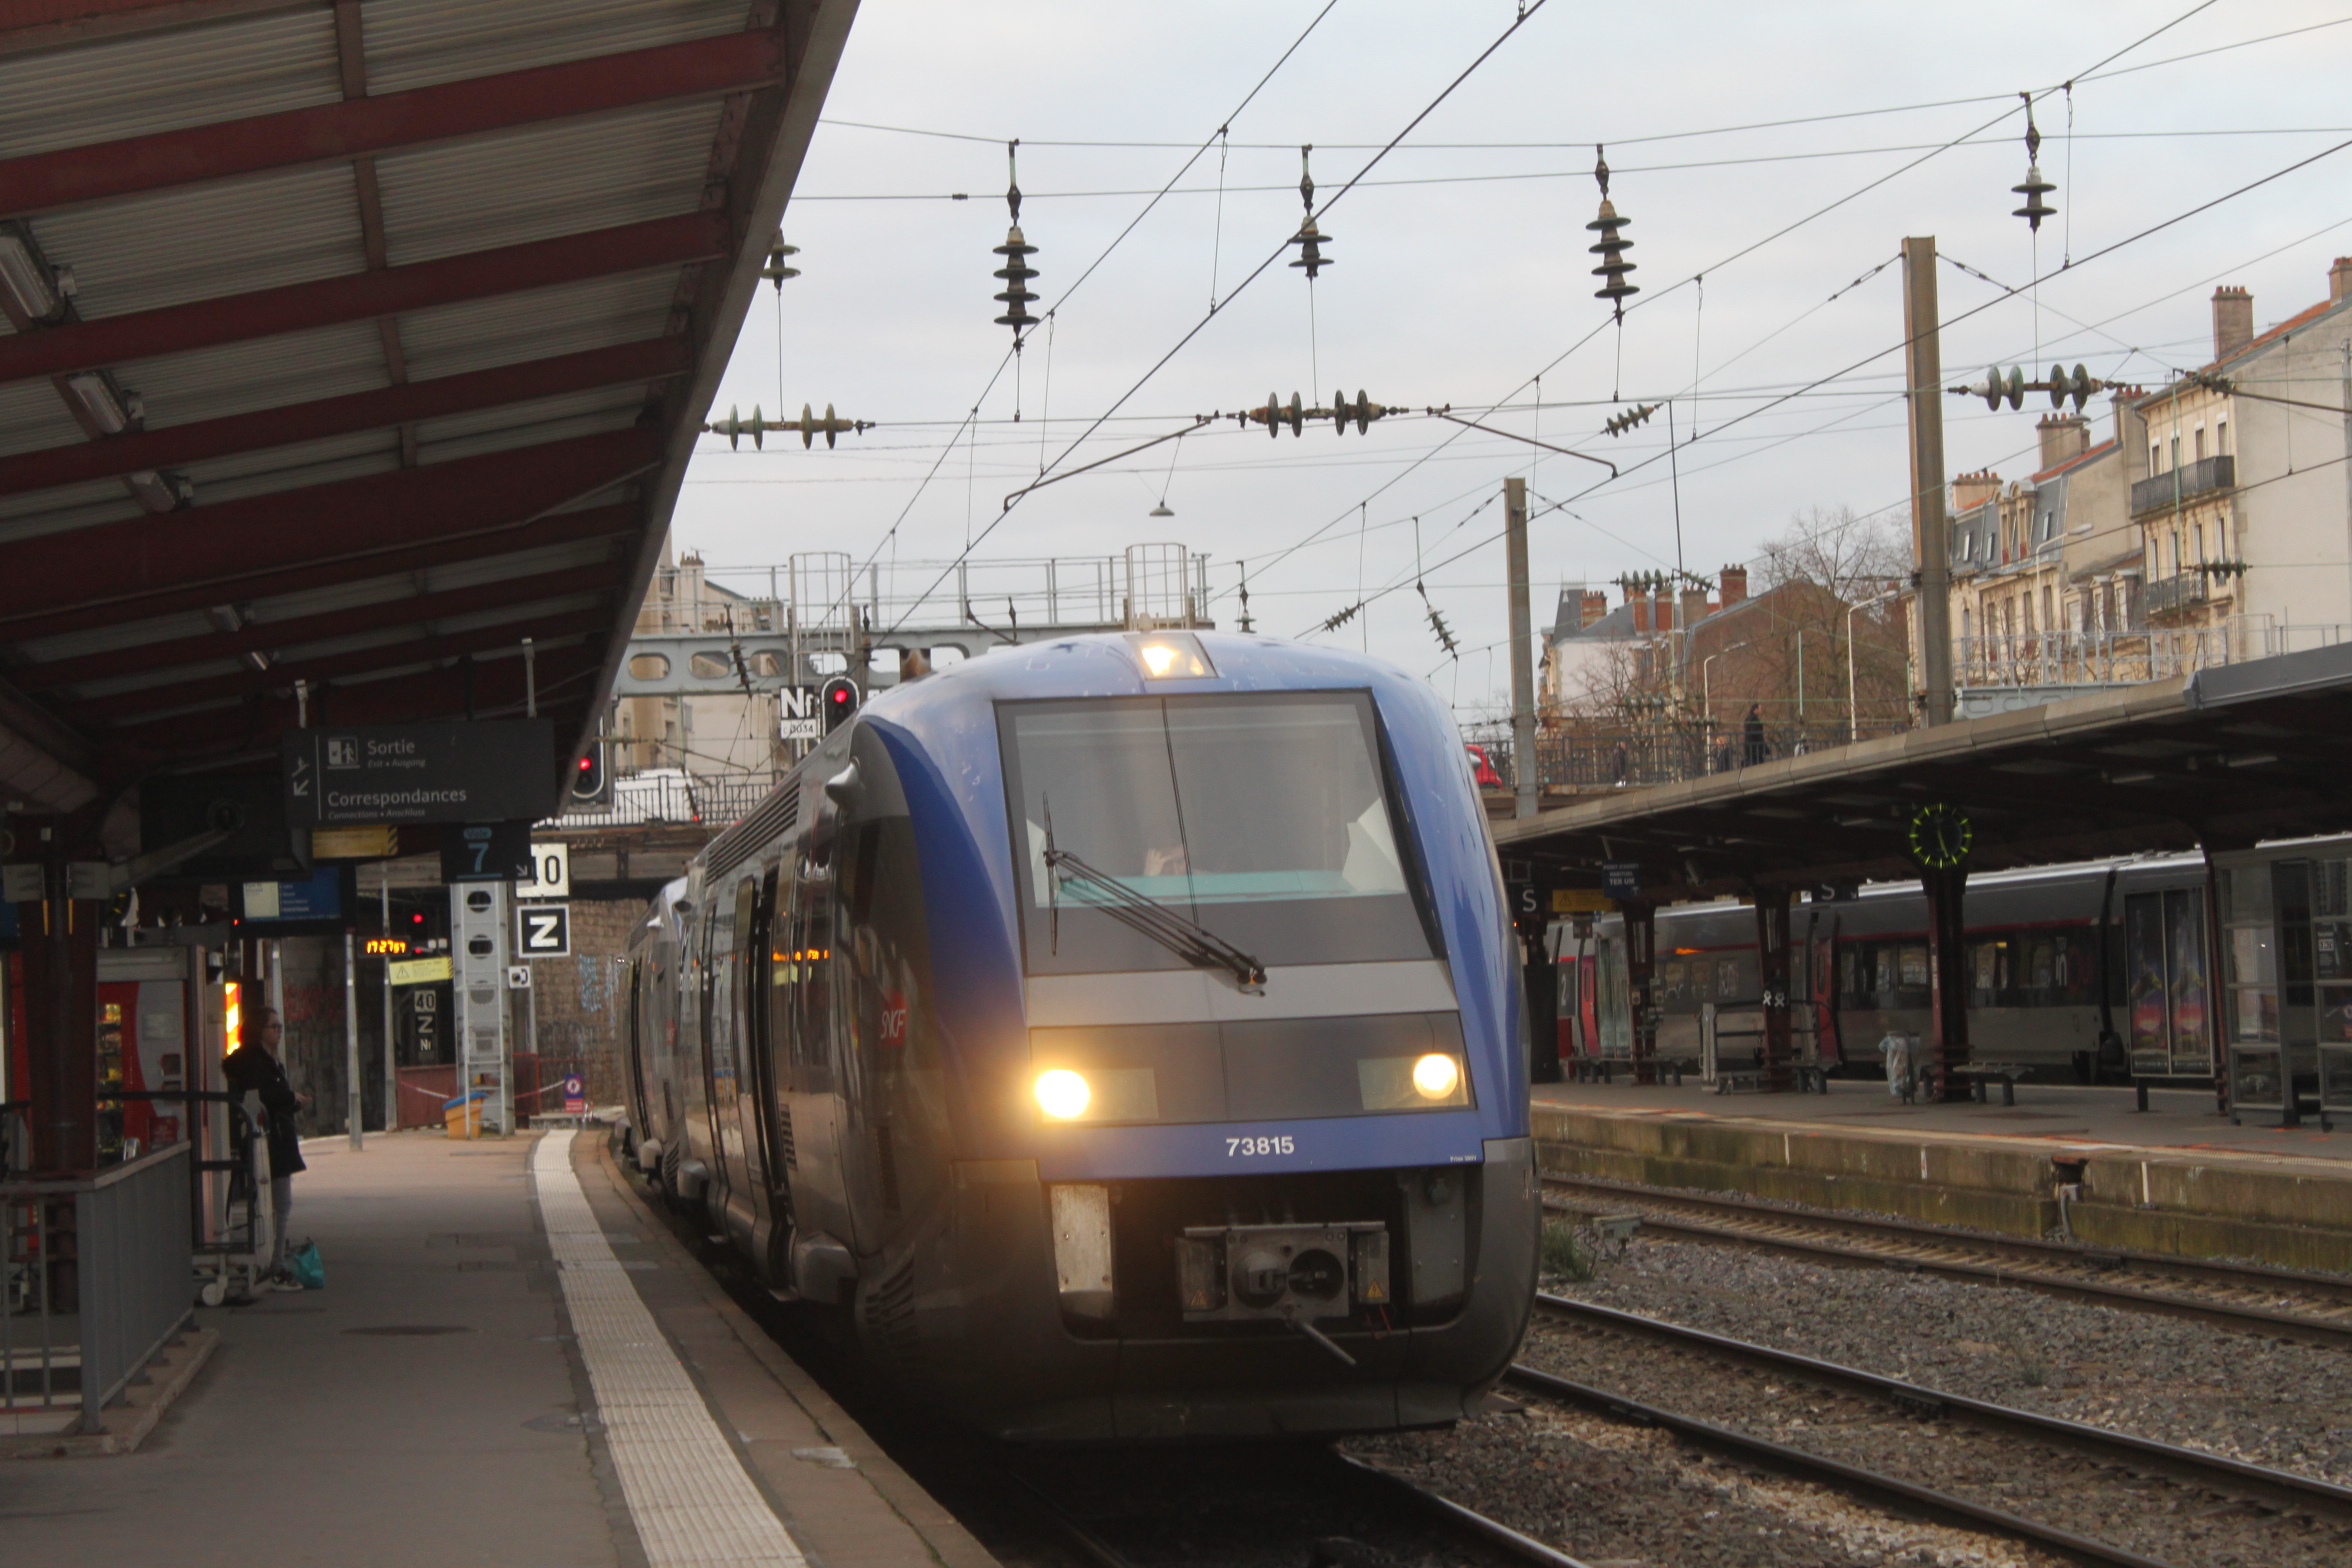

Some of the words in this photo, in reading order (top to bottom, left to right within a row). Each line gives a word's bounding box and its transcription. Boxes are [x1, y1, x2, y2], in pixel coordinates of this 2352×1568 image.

[781, 687, 815, 718] Nf
[368, 739, 415, 756] Sortie
[328, 788, 467, 808] Correspondances
[468, 843, 489, 873] 7
[1522, 889, 1537, 912] S
[529, 916, 558, 948] Z
[416, 993, 435, 1009] 40
[1226, 1136, 1295, 1156] 73815
